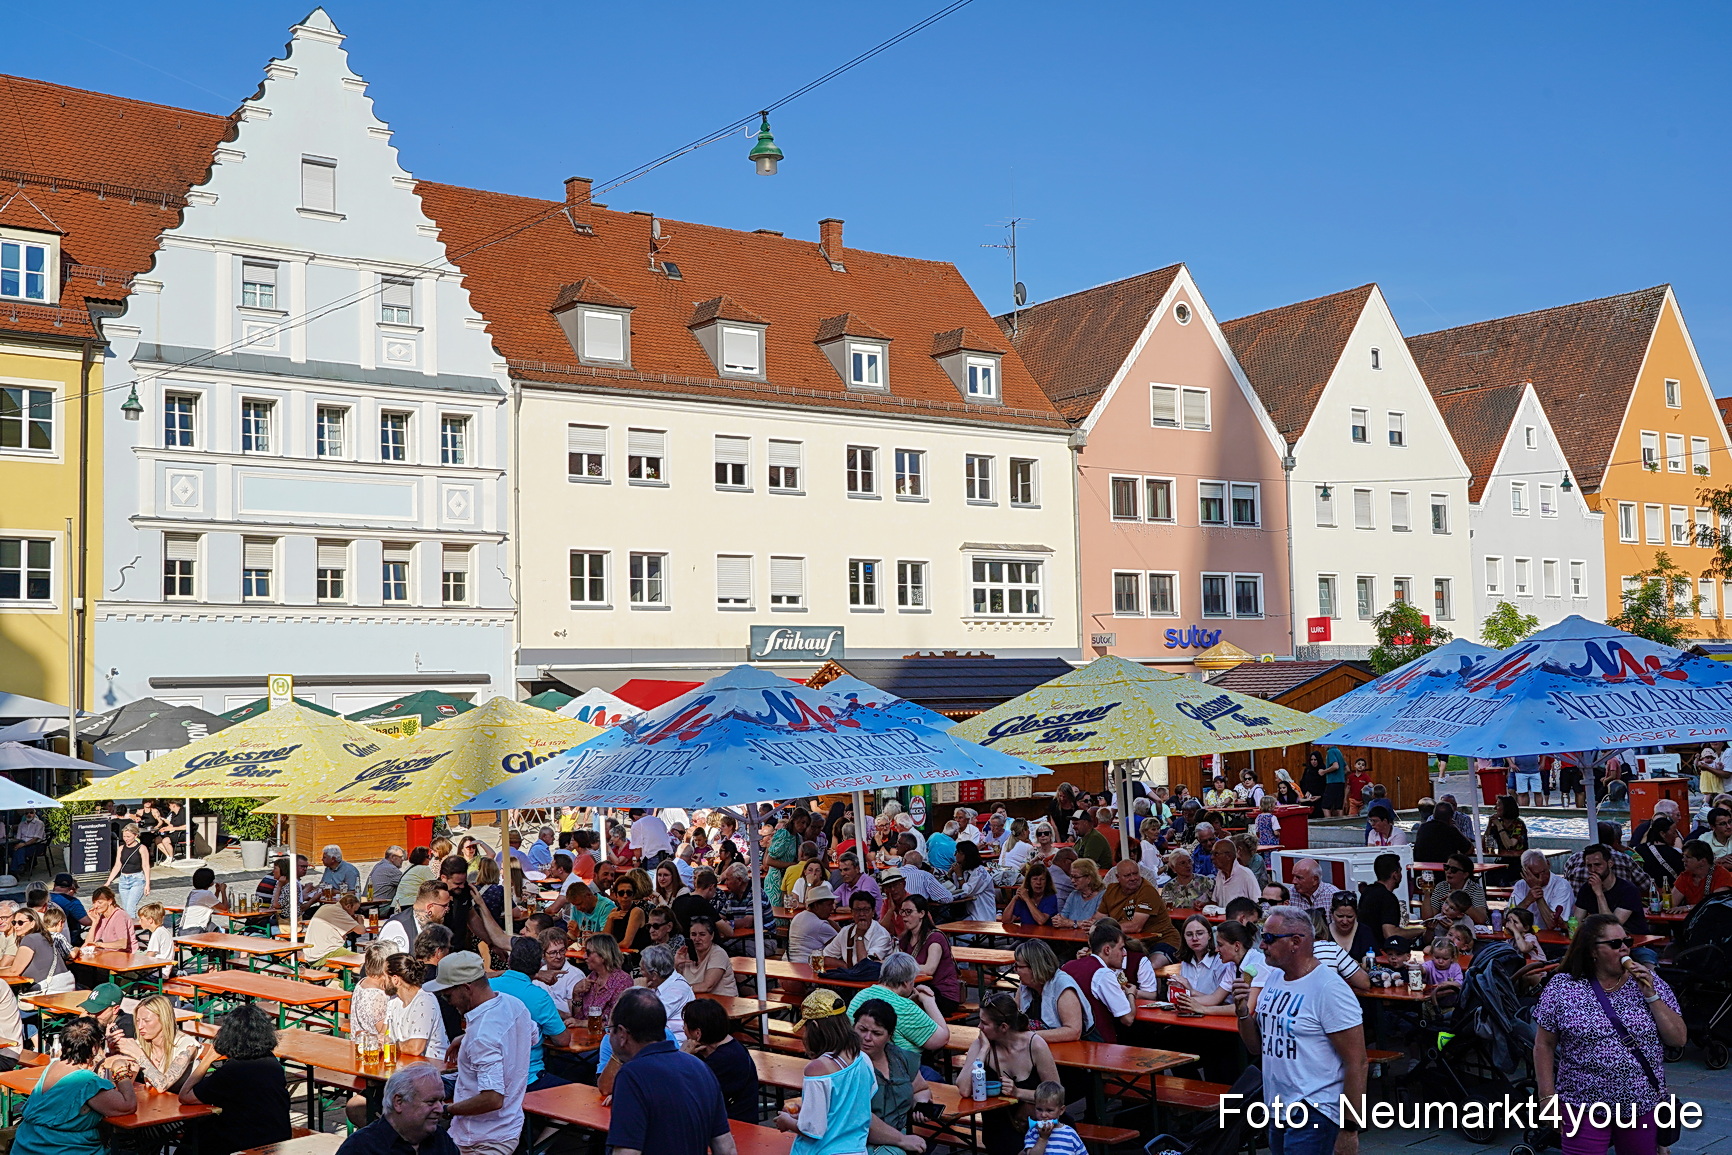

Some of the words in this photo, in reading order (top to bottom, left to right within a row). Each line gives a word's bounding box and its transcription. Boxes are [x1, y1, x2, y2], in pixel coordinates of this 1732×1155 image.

[756, 628, 841, 657] frühauf
[1165, 625, 1222, 648] sutor
[979, 702, 1122, 746] Glossner
[1175, 694, 1244, 731] Glossner
[1231, 712, 1273, 727] Bier
[747, 728, 943, 766] NEUMARKTER
[1035, 726, 1098, 744] Bier
[1600, 729, 1680, 744] WASSER
[1688, 727, 1727, 736] ZUM
[173, 744, 303, 780] Glossner
[226, 764, 283, 778] Bier
[801, 755, 940, 778] MINERALBRUNNEN
[807, 775, 879, 790] WASSER
[882, 773, 914, 782] ZUM
[919, 768, 960, 779] LEBEN
[1260, 987, 1275, 1011] SEE
[1269, 988, 1305, 1018] YOU
[1271, 1014, 1296, 1039] THE
[1262, 1034, 1297, 1060] EACH
